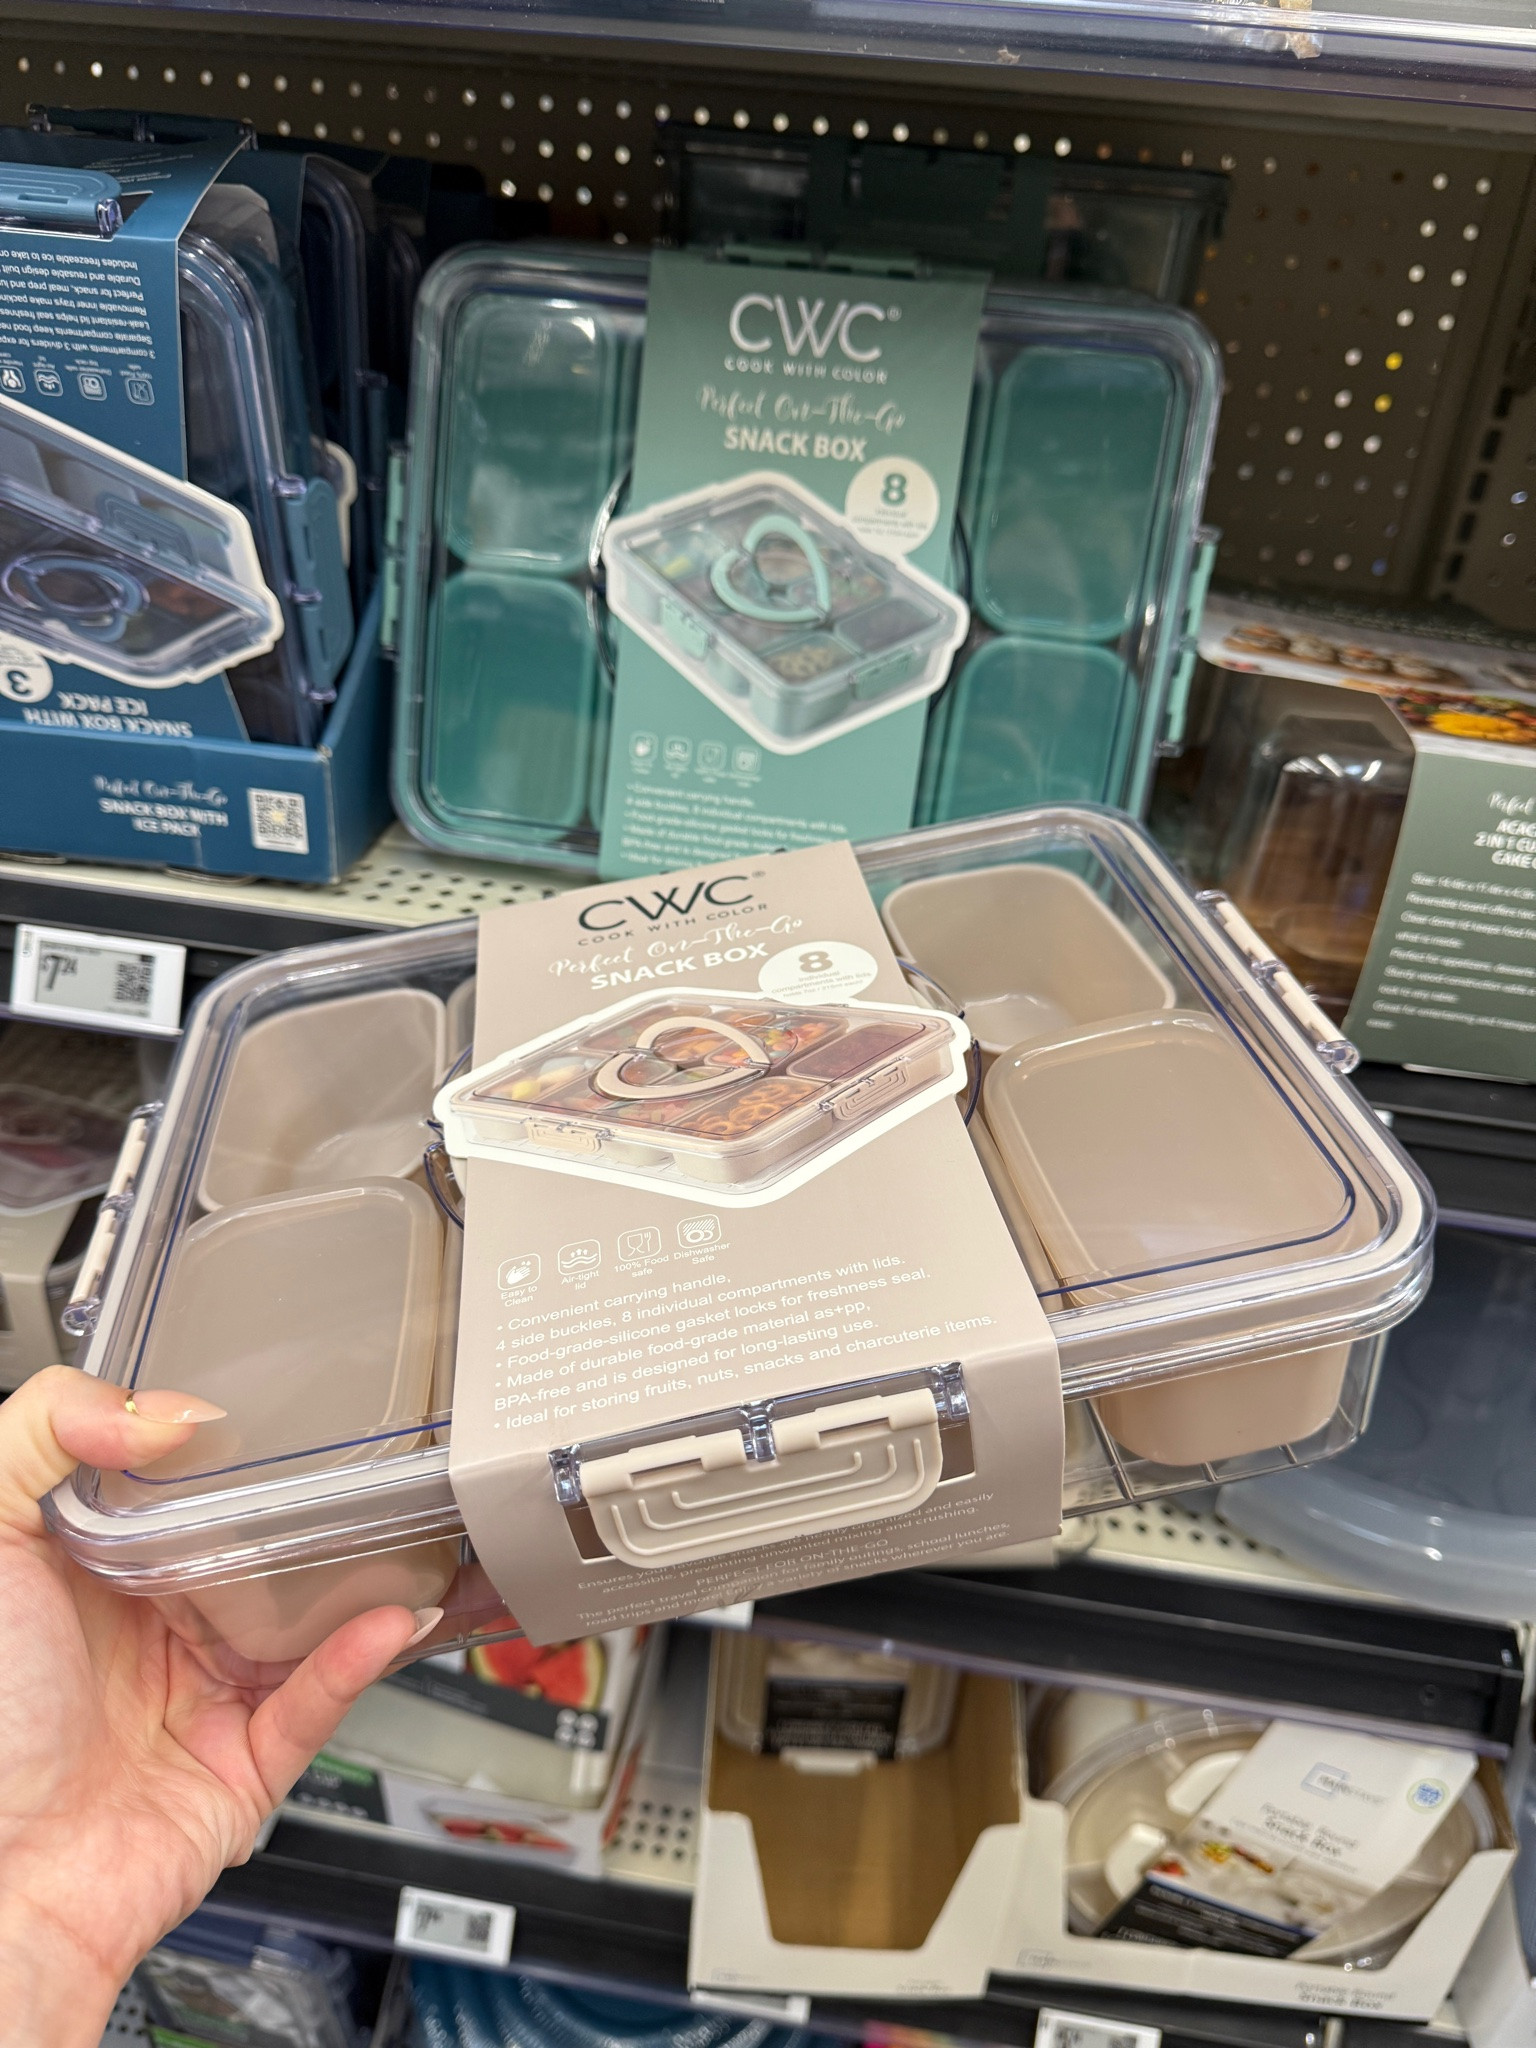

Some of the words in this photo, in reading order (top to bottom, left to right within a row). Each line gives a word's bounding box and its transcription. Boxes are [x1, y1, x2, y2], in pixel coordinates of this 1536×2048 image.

[11, 250, 30, 261] take
[32, 253, 39, 262] to
[42, 253, 55, 263] ice
[56, 255, 100, 267] freezeable
[2, 265, 20, 276] built
[101, 259, 138, 270] Includes
[22, 265, 50, 279] design
[52, 269, 88, 281] reusable
[89, 273, 106, 283] and
[9, 281, 26, 291] and
[27, 281, 47, 292] prep
[107, 274, 141, 286] Durable
[48, 284, 69, 294] meal
[100, 289, 112, 299] for
[114, 290, 144, 301] Perfect
[29, 297, 52, 307] make
[54, 298, 75, 308] trays
[77, 301, 98, 310] inner
[36, 312, 54, 320] seal
[99, 303, 147, 316] Removable
[56, 312, 78, 323] helps
[79, 316, 90, 324] lid
[91, 317, 150, 330] Leak-resistant
[13, 324, 32, 335] food
[33, 324, 54, 335] keep
[55, 327, 113, 342] compartments
[18, 338, 30, 347] for
[31, 339, 62, 348] dividers
[115, 333, 153, 345] Separate
[71, 343, 89, 351] with
[90, 345, 148, 358] compartments
[149, 350, 155, 359] 3
[724, 357, 774, 375] COOK
[782, 362, 827, 378] WITH
[832, 366, 888, 384] COLOR
[724, 424, 809, 457] SNACK
[812, 433, 868, 462] BOX
[882, 472, 907, 507] 8
[7, 671, 34, 697] 3
[57, 692, 113, 713] PACK
[112, 697, 148, 717] ICE
[22, 708, 79, 728] WITH
[79, 713, 123, 733] BOX
[121, 716, 193, 738] SNACK
[98, 797, 151, 816] SNACK
[153, 802, 188, 819] BOX
[189, 806, 229, 827] WITH
[131, 817, 160, 833] ICE
[161, 818, 202, 838] PACK
[578, 930, 634, 946] COOK
[647, 918, 696, 932] WITH
[706, 904, 768, 921] COLOR
[548, 946, 635, 977] Perfect
[647, 915, 803, 957] On-The-Go
[590, 956, 698, 990] SNACK
[703, 942, 769, 968] BOX
[798, 951, 833, 973] 8
[798, 970, 841, 982] individual
[673, 1242, 731, 1260] Dishwasher
[614, 1262, 642, 1273] 100%
[644, 1255, 669, 1266] Food
[692, 1254, 715, 1265] Safe
[561, 1270, 600, 1285] Air-tight
[632, 1268, 653, 1278] safe
[501, 1289, 525, 1300] Easy
[528, 1284, 538, 1293] to
[575, 1281, 586, 1290] lid
[495, 1340, 506, 1351] 4
[511, 1331, 545, 1349] side
[550, 1316, 617, 1340] buckles,
[622, 1311, 632, 1323] 8
[637, 1294, 712, 1319] individual
[717, 1269, 832, 1301] compartments
[836, 1261, 869, 1277] with
[872, 1255, 905, 1269] lids.
[504, 1295, 534, 1308] Clean
[508, 1301, 600, 1330] Convenient
[604, 1285, 668, 1308] carrying
[672, 1273, 731, 1293] handle,
[507, 1323, 671, 1369] Food-grade-silicone
[676, 1307, 731, 1332] gasket
[734, 1300, 777, 1318] locks
[781, 1294, 803, 1308] for
[807, 1277, 888, 1302] freshness
[892, 1268, 931, 1284] seal.
[507, 1369, 554, 1388] Made
[558, 1362, 576, 1376] of
[580, 1348, 643, 1371] durable
[648, 1328, 738, 1356] food-grade
[743, 1311, 809, 1335] material
[814, 1302, 871, 1320] as+pp,
[494, 1386, 571, 1411] BPA-free
[575, 1375, 608, 1392] and
[613, 1372, 627, 1384] is
[632, 1351, 709, 1381] designed
[714, 1347, 737, 1363] for
[741, 1325, 838, 1356] long-lasting
[843, 1320, 879, 1334] use.
[506, 1410, 548, 1429] Ideal
[553, 1404, 577, 1419] for
[581, 1390, 640, 1414] storing
[645, 1379, 692, 1397] fruits,
[697, 1369, 738, 1386] nuts,
[744, 1352, 804, 1375] snacks
[809, 1346, 841, 1361] and
[846, 1324, 941, 1353] charcuterie
[944, 1314, 998, 1333] items.
[578, 1574, 633, 1589] Ensures
[636, 1568, 667, 1579] your
[851, 1510, 922, 1530] organized
[925, 1502, 952, 1514] and
[955, 1492, 994, 1507] easily
[602, 1574, 677, 1593] accessible,
[680, 1555, 756, 1578] preventing
[760, 1537, 831, 1558] unwanted
[834, 1528, 882, 1545] mixing
[885, 1521, 912, 1532] and
[915, 1506, 979, 1525] crushing.
[696, 1566, 761, 1586] PERFECT
[766, 1559, 796, 1571] FOR
[800, 1539, 889, 1562] ON-THE-GO
[576, 1611, 603, 1619] The
[607, 1599, 655, 1615] perfect
[659, 1589, 698, 1602] travel
[700, 1571, 778, 1593] companion
[781, 1566, 799, 1575] for
[803, 1557, 845, 1571] family
[848, 1545, 904, 1561] outings,
[906, 1534, 951, 1549] school
[954, 1522, 1010, 1540] lunches,
[586, 1615, 617, 1626] road
[620, 1609, 651, 1619] trips
[654, 1602, 680, 1613] and
[777, 1570, 823, 1584] variety
[827, 1565, 842, 1575] of
[843, 1557, 888, 1571] snacks
[890, 1545, 952, 1561] wherever
[956, 1537, 983, 1548] you
[986, 1531, 1010, 1541] are.
